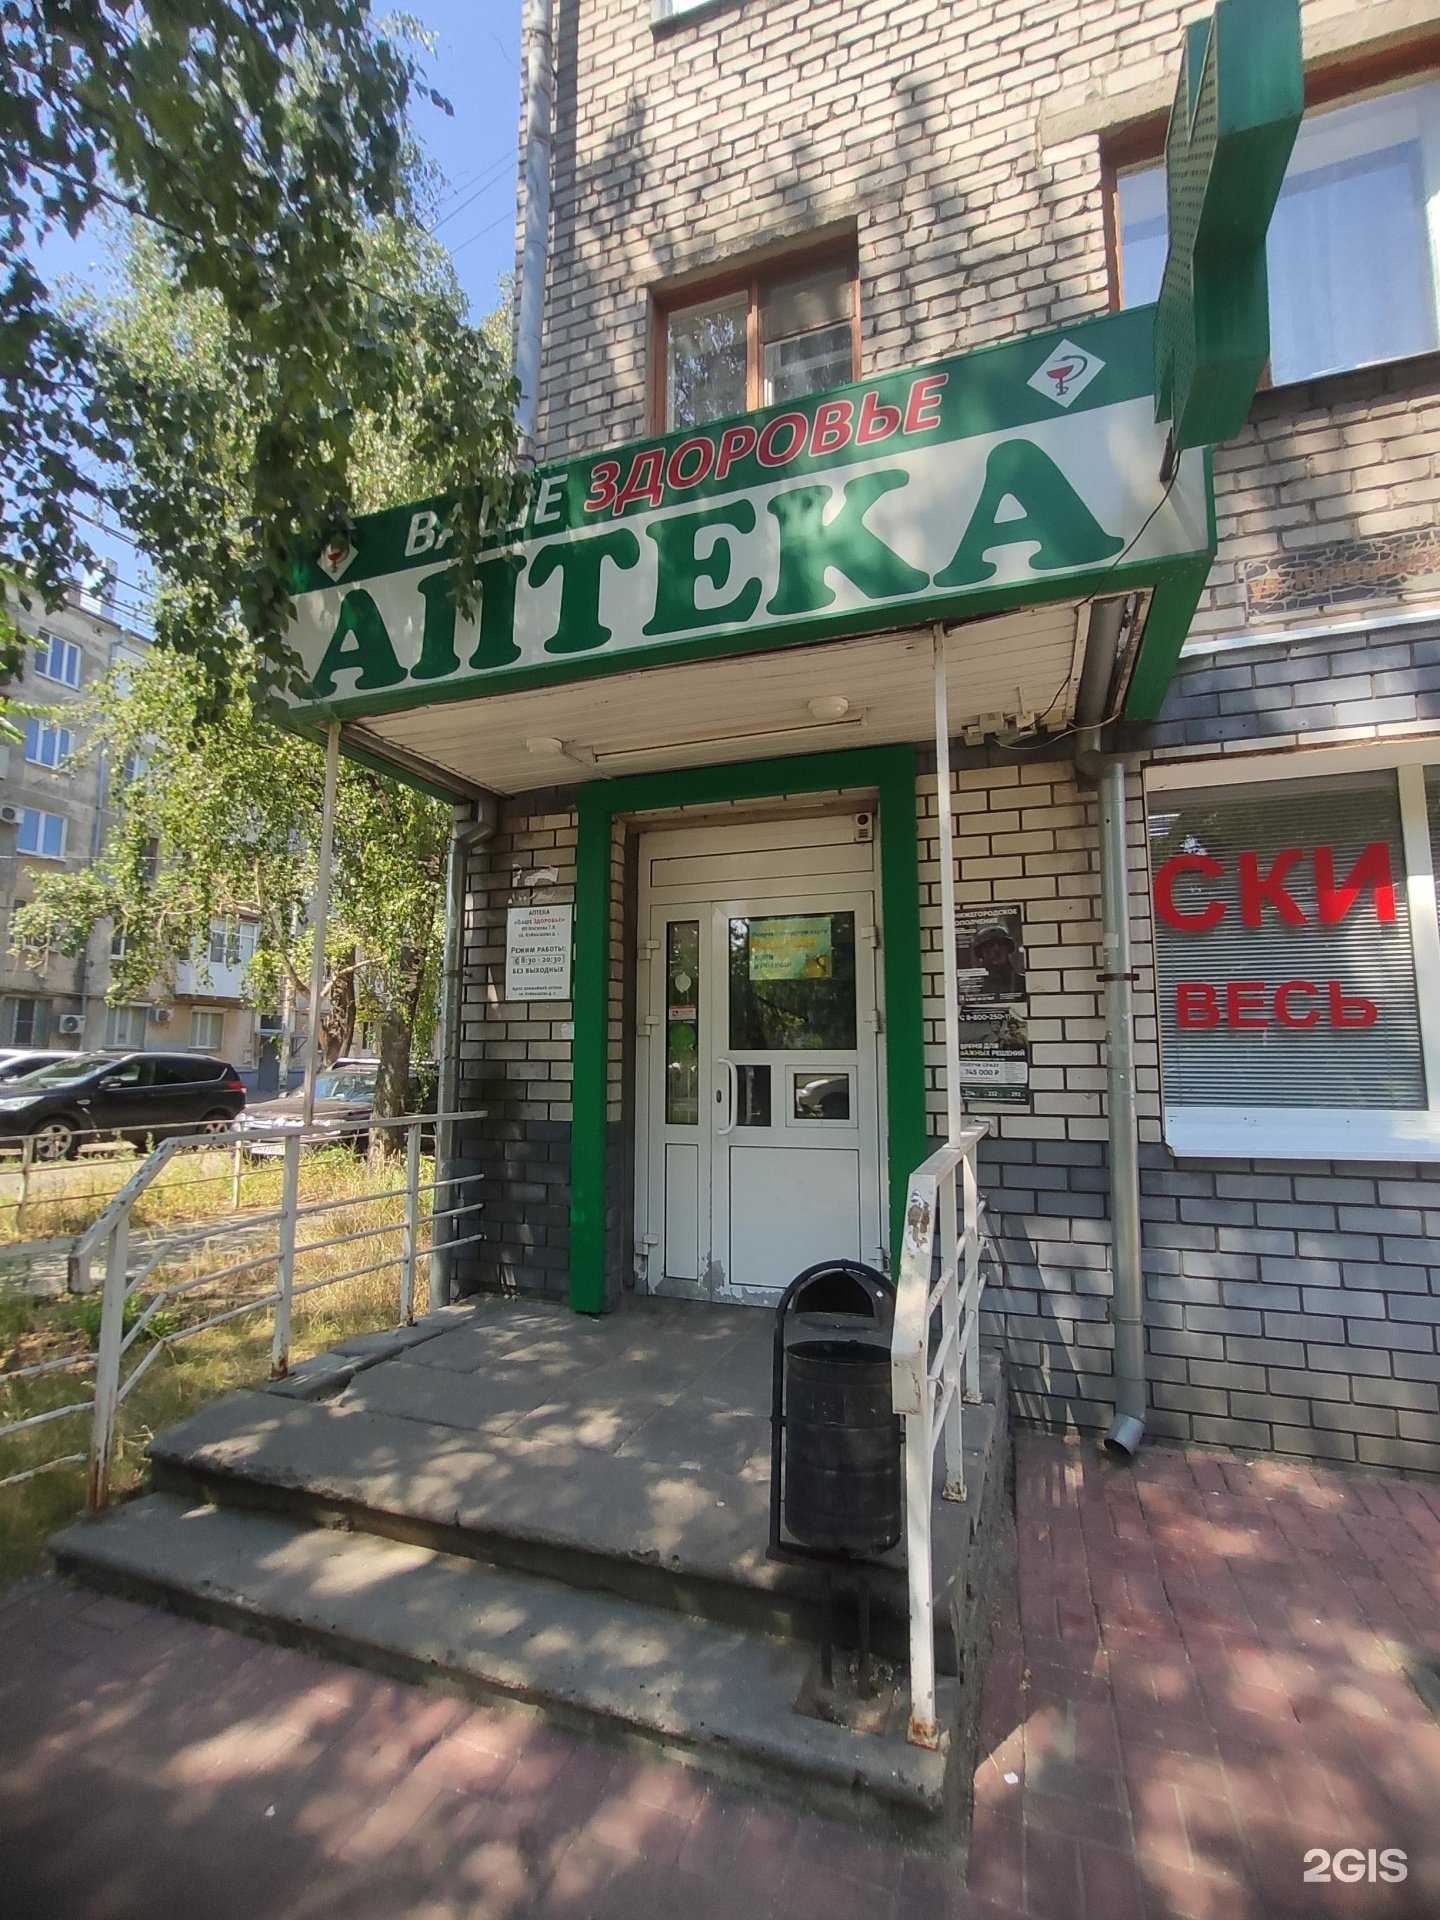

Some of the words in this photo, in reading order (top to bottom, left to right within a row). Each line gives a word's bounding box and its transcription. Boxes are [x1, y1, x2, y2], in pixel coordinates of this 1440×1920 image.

[583, 372, 950, 516] ЗДОРОВЬЕ
[308, 438, 1125, 700] АПТЕКА
[1153, 840, 1397, 933] СКИ
[1175, 980, 1379, 1029] ВЕСЬ
